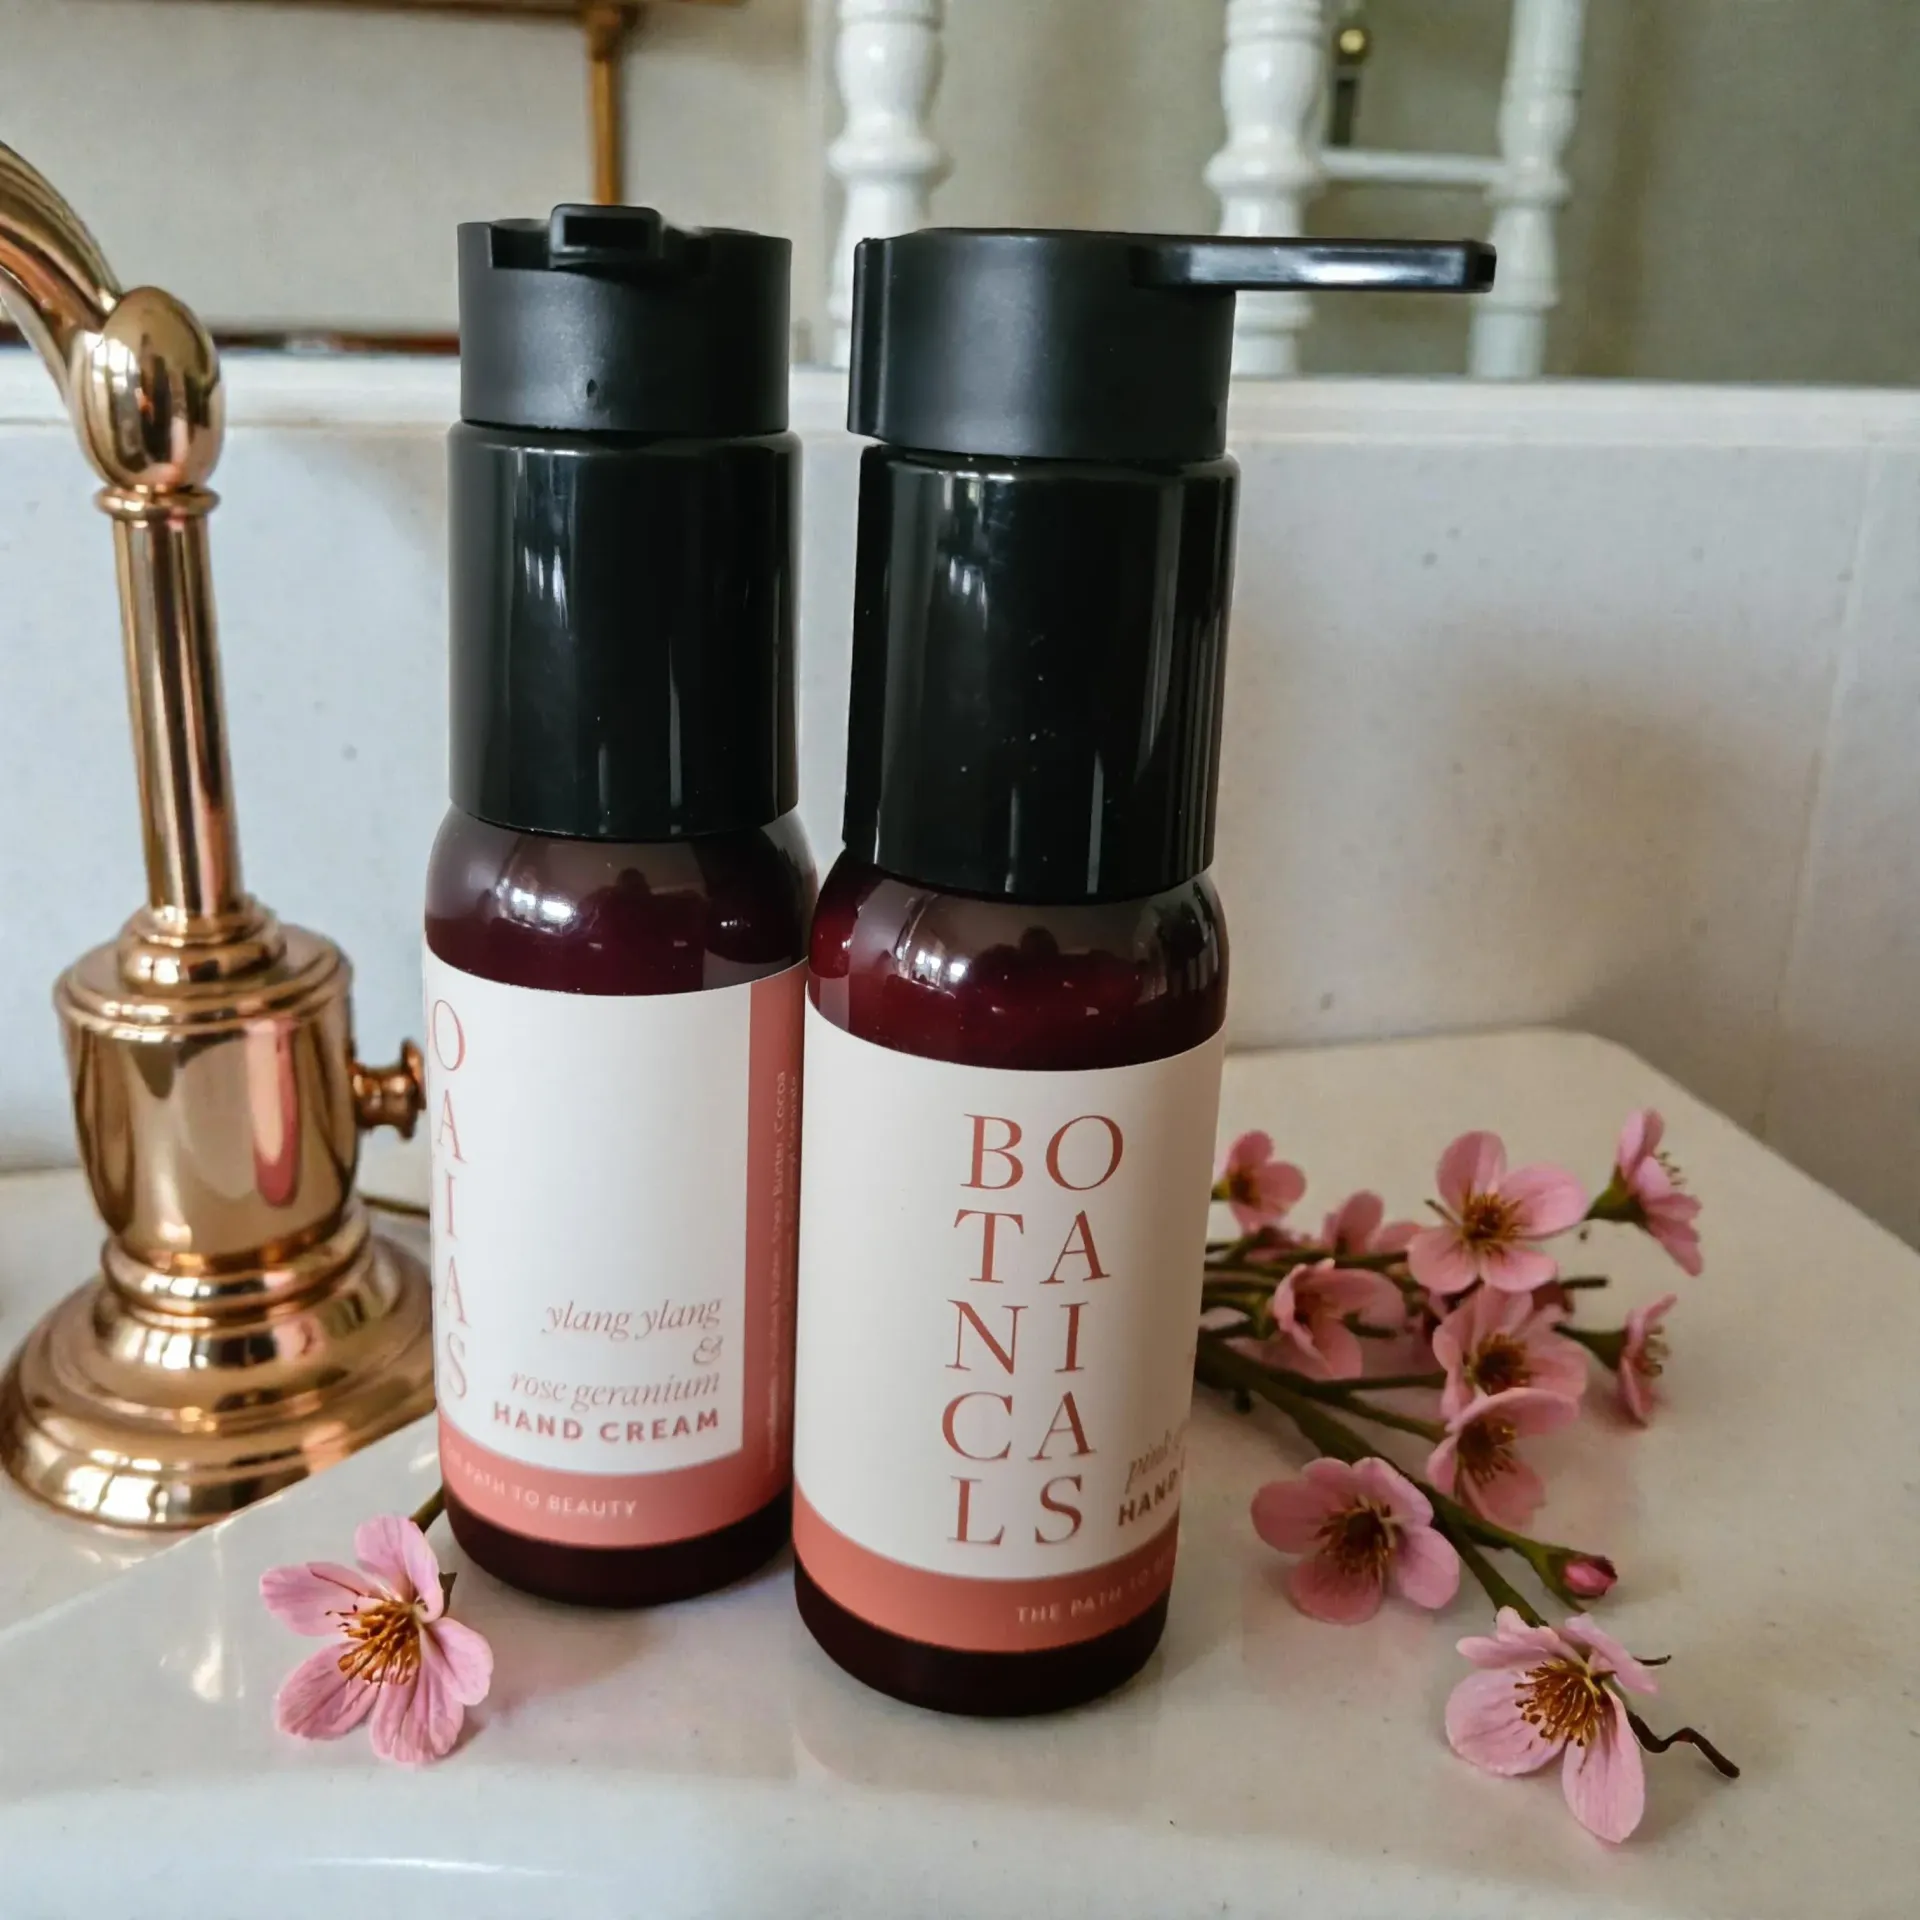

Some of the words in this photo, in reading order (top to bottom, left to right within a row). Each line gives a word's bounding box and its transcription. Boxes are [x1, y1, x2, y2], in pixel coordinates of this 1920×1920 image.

[774, 1071, 785, 1133] Cocoa
[540, 1299, 630, 1339] ylang
[635, 1299, 722, 1340] ylang
[693, 1335, 723, 1365] &
[510, 1371, 567, 1401] rose
[571, 1371, 720, 1413] geranium
[493, 1401, 583, 1441] HAND
[599, 1408, 719, 1443] CREAM
[465, 1461, 506, 1496] PATH
[512, 1484, 541, 1508] TO
[548, 1493, 638, 1519] BEAUTY
[1016, 1602, 1061, 1625] THE
[1070, 1586, 1122, 1618] PATH
